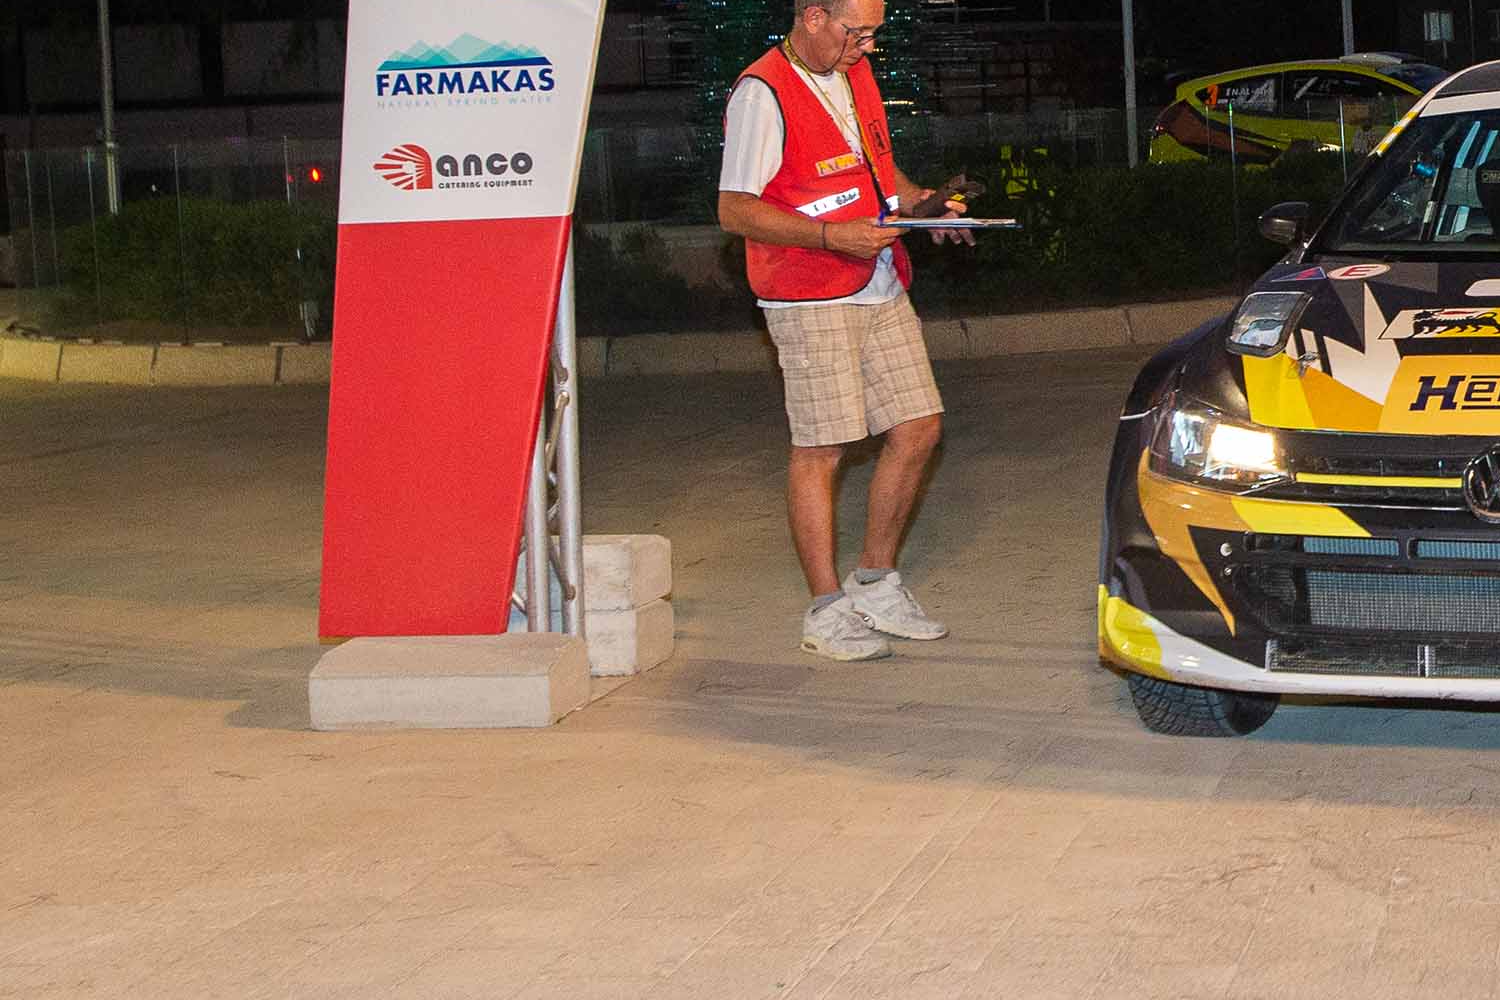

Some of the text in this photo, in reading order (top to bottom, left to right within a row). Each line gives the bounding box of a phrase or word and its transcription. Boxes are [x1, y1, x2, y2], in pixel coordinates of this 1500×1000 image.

[376, 68, 555, 97] FARMAKAS
[436, 152, 533, 177] anco
[438, 179, 533, 189] CATERING EQUIPMENT
